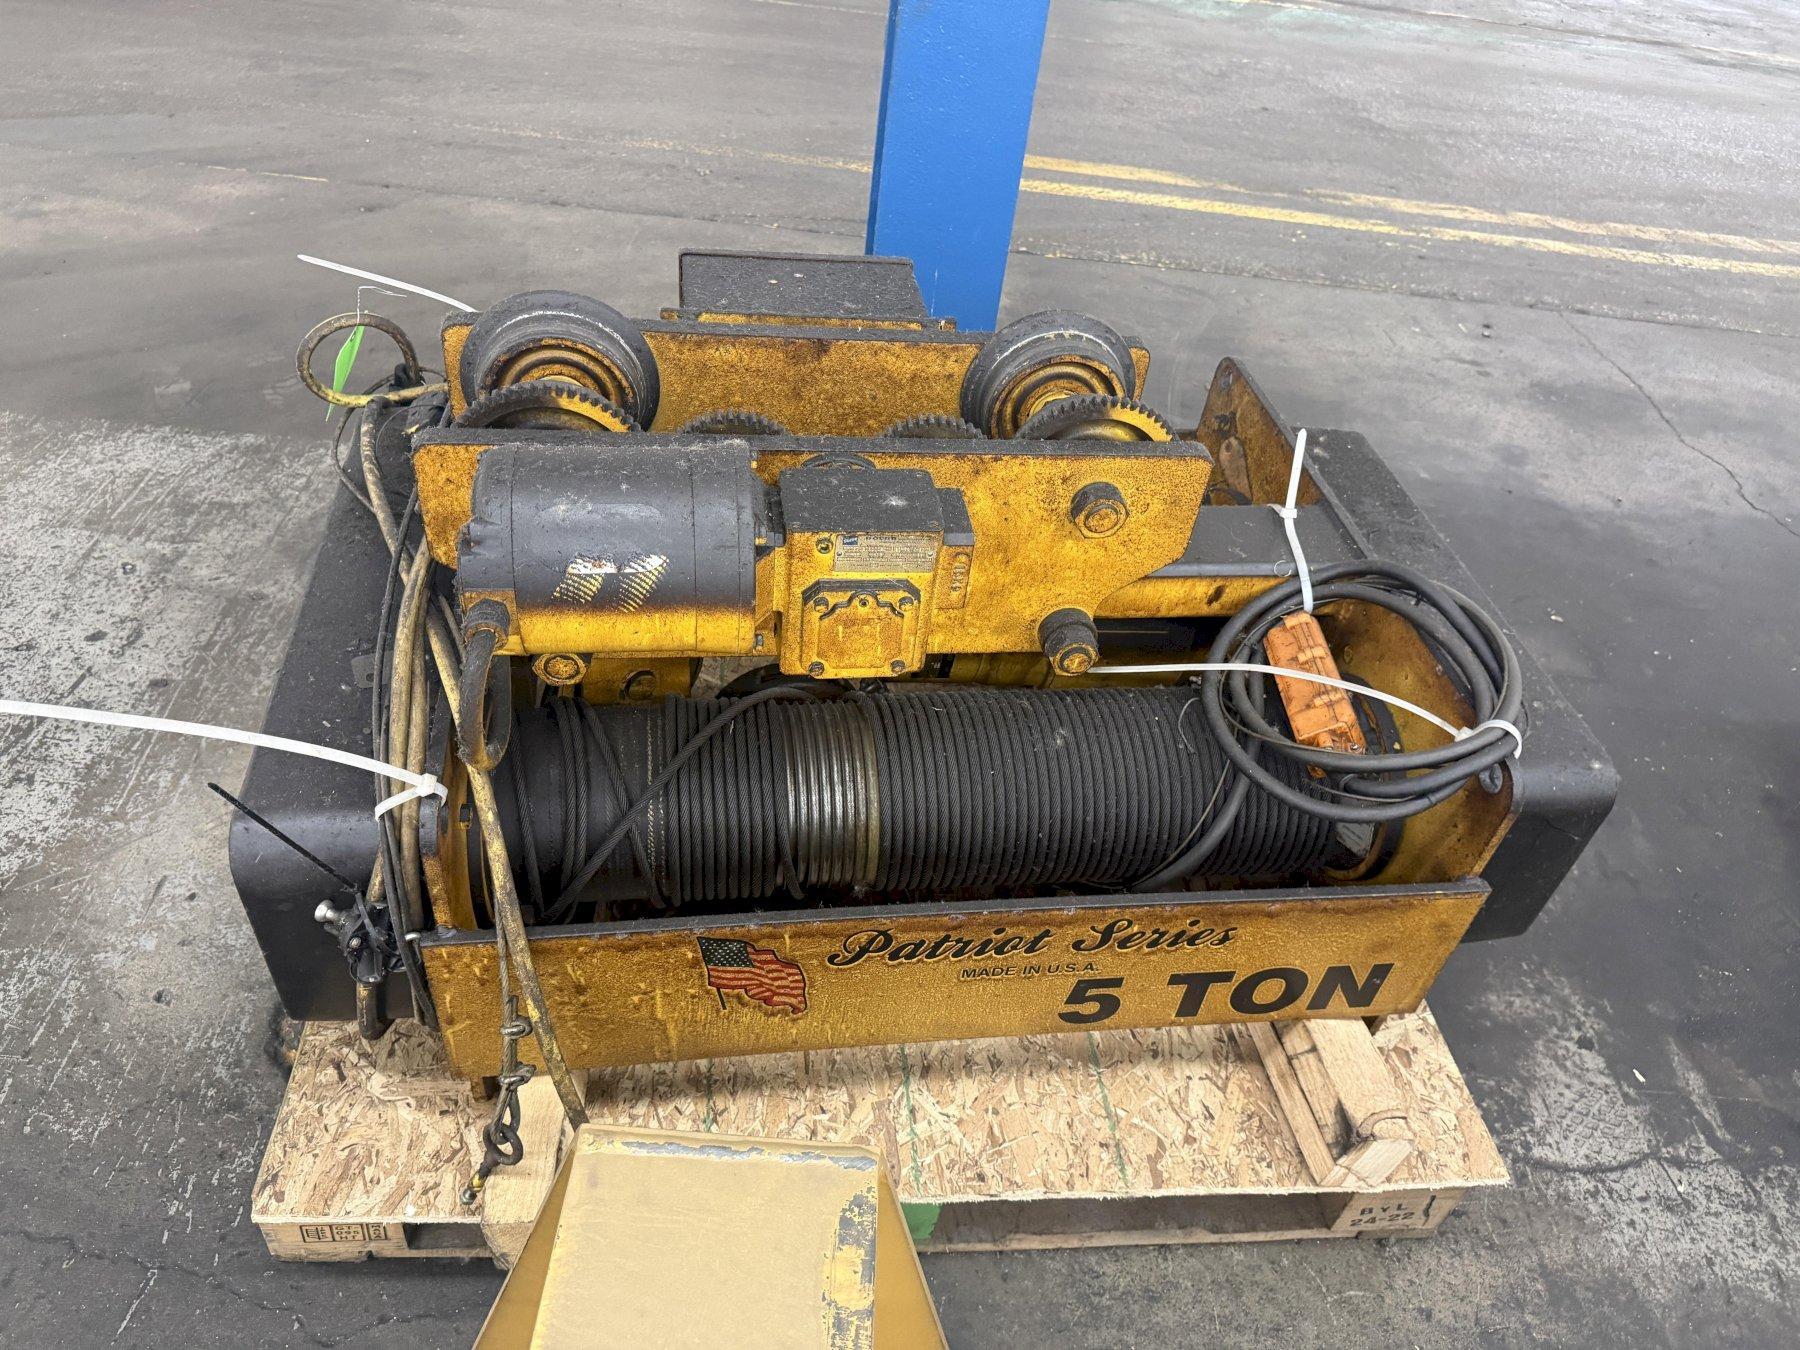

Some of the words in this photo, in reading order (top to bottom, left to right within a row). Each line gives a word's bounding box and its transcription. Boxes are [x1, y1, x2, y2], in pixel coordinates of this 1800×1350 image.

[826, 926, 1054, 967] Patriot
[1071, 918, 1239, 954] Series
[960, 964, 1017, 979] MADE
[1022, 963, 1041, 977] IN
[1047, 962, 1101, 976] U.S.A.
[1057, 976, 1126, 1025] 5
[1166, 962, 1396, 1019] TON
